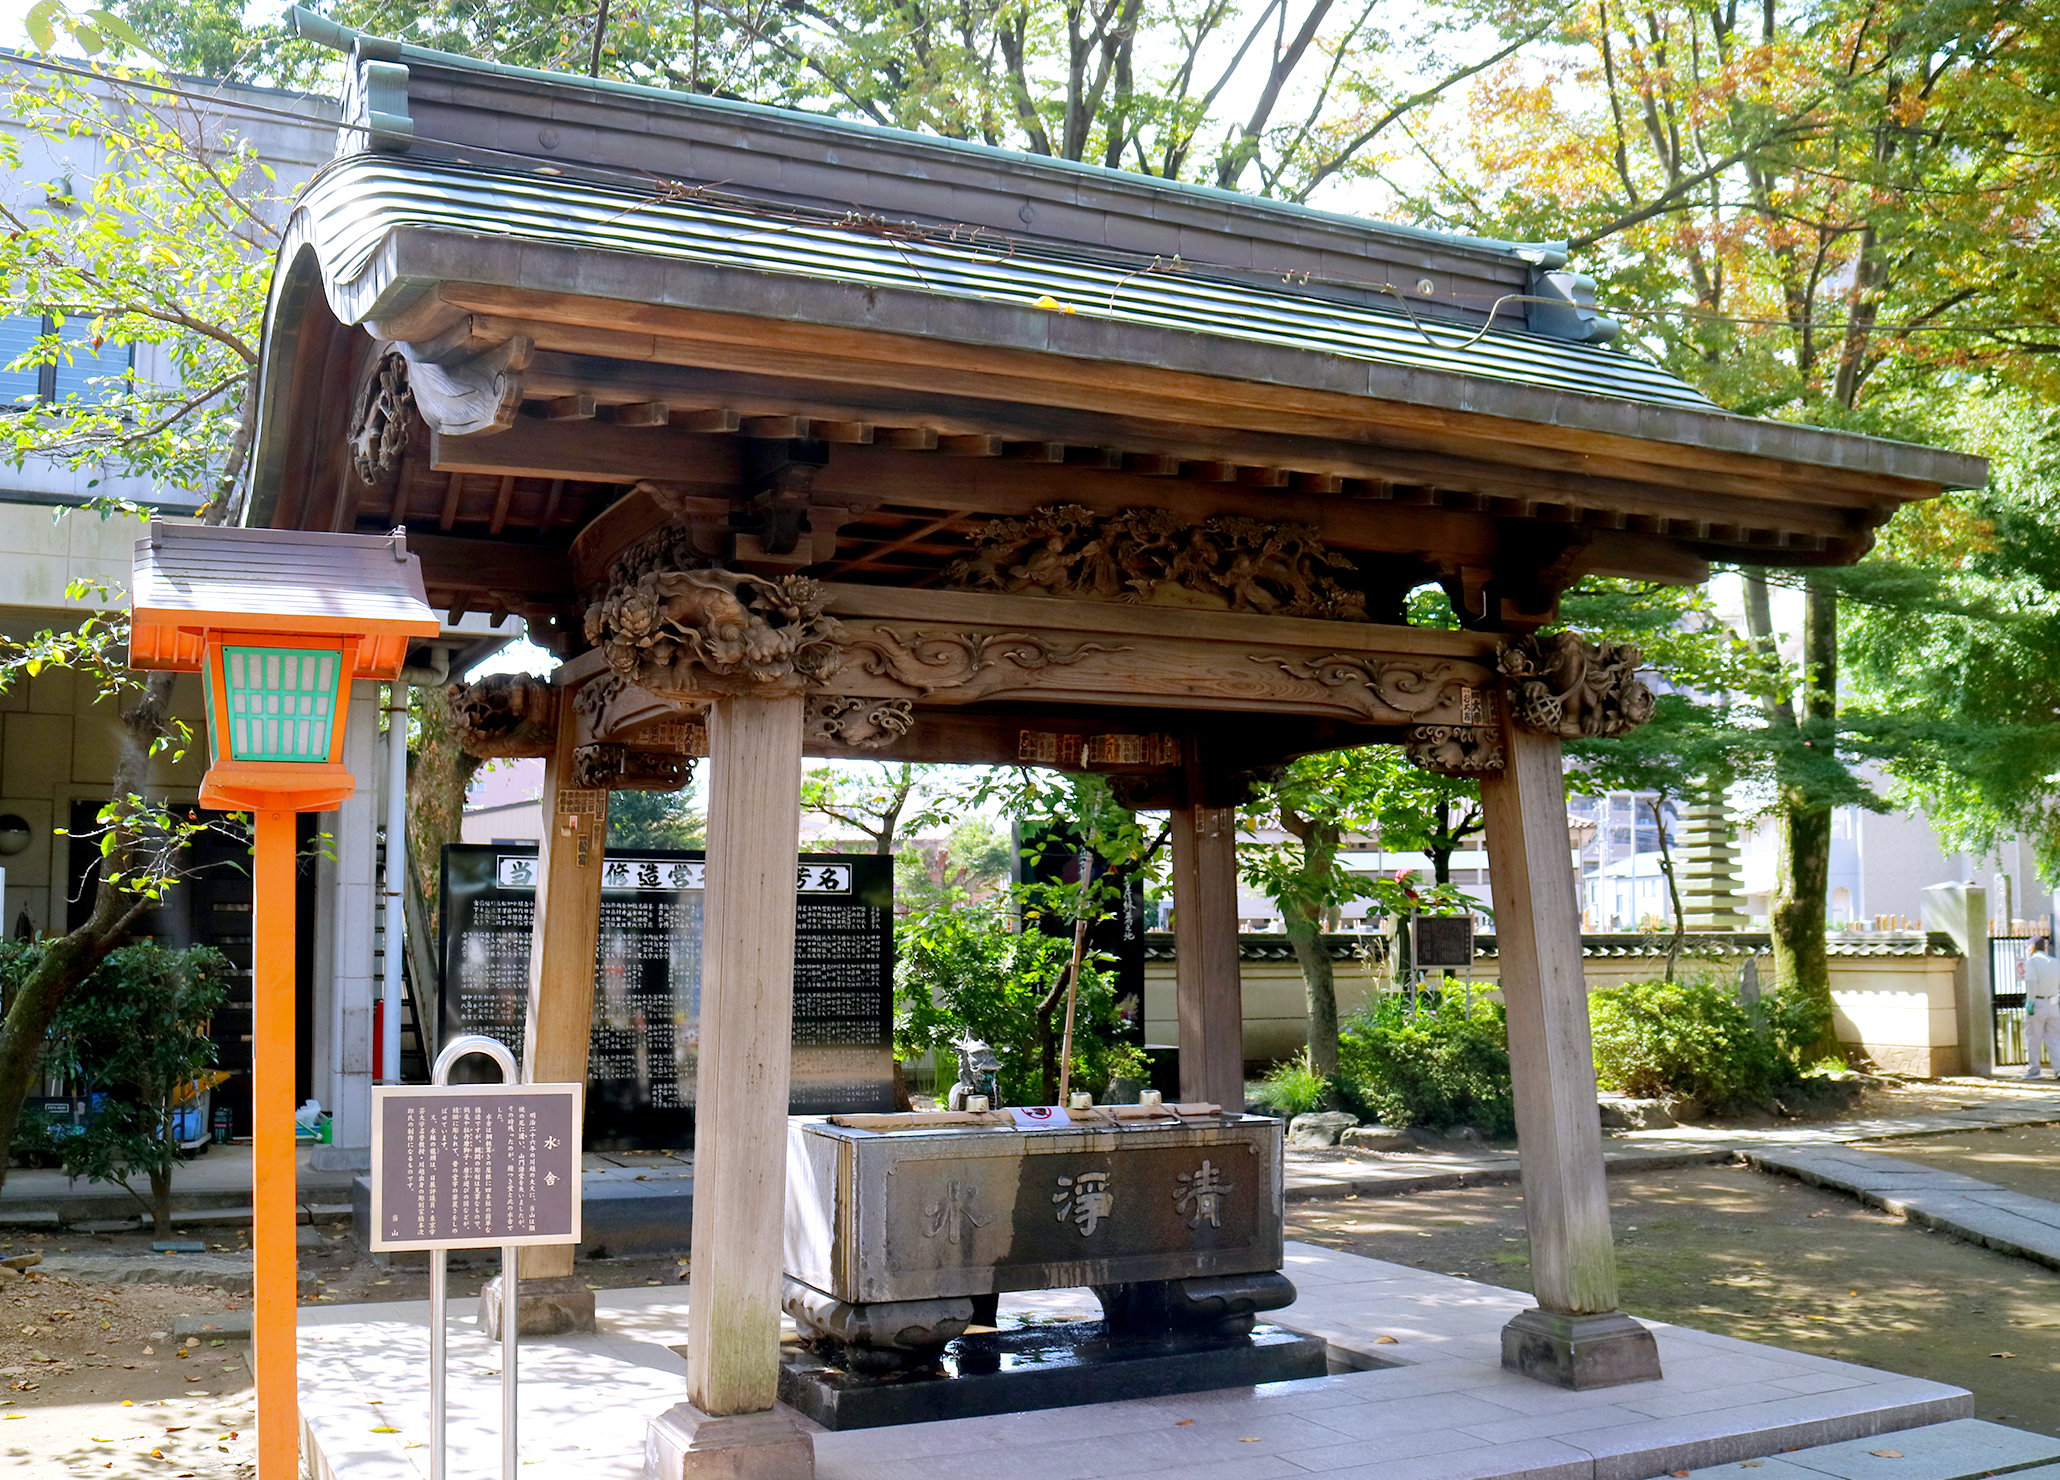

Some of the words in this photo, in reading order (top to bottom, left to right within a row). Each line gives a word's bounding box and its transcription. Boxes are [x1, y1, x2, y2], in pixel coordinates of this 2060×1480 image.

[440, 1107, 449, 1151] ばせています。
[496, 1106, 504, 1123] した。
[543, 1135, 557, 1187] 水舎
